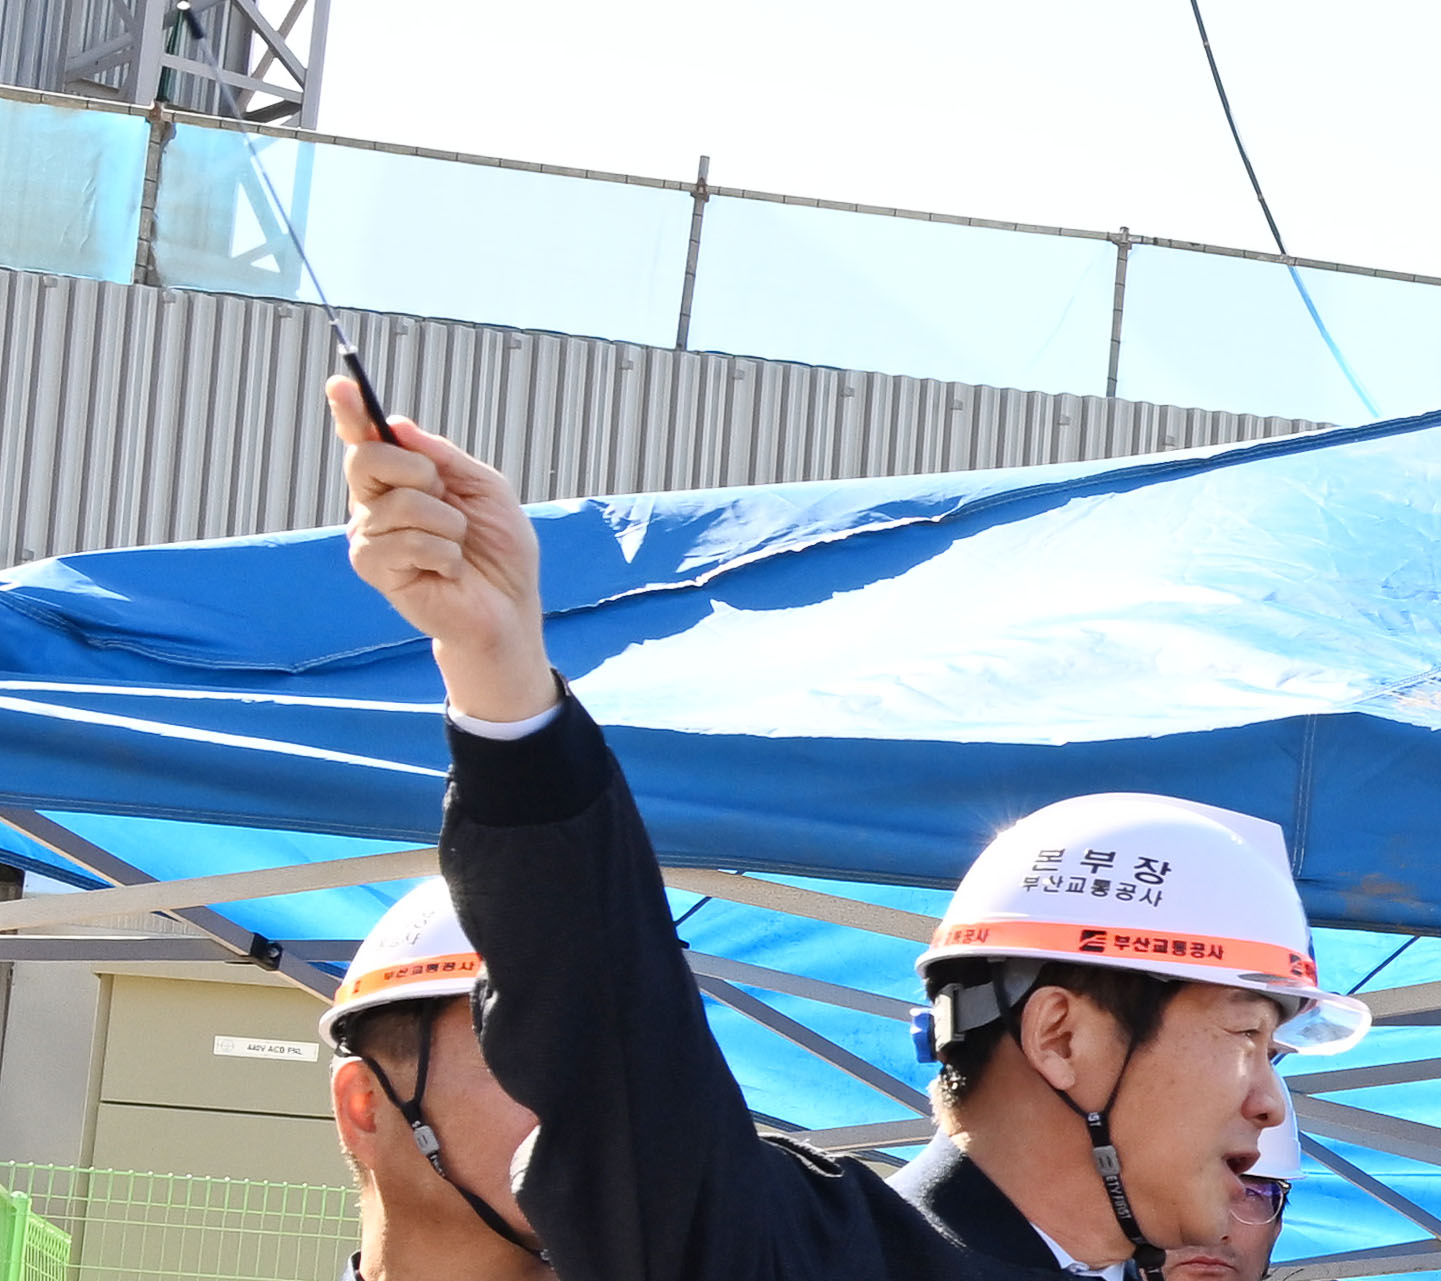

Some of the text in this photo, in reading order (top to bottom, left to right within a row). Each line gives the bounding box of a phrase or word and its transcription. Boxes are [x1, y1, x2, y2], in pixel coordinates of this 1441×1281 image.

[1022, 875, 1163, 908] 부산교통공사
[1114, 935, 1224, 960] 부산교통공사
[384, 961, 474, 981] 부산교통공사
